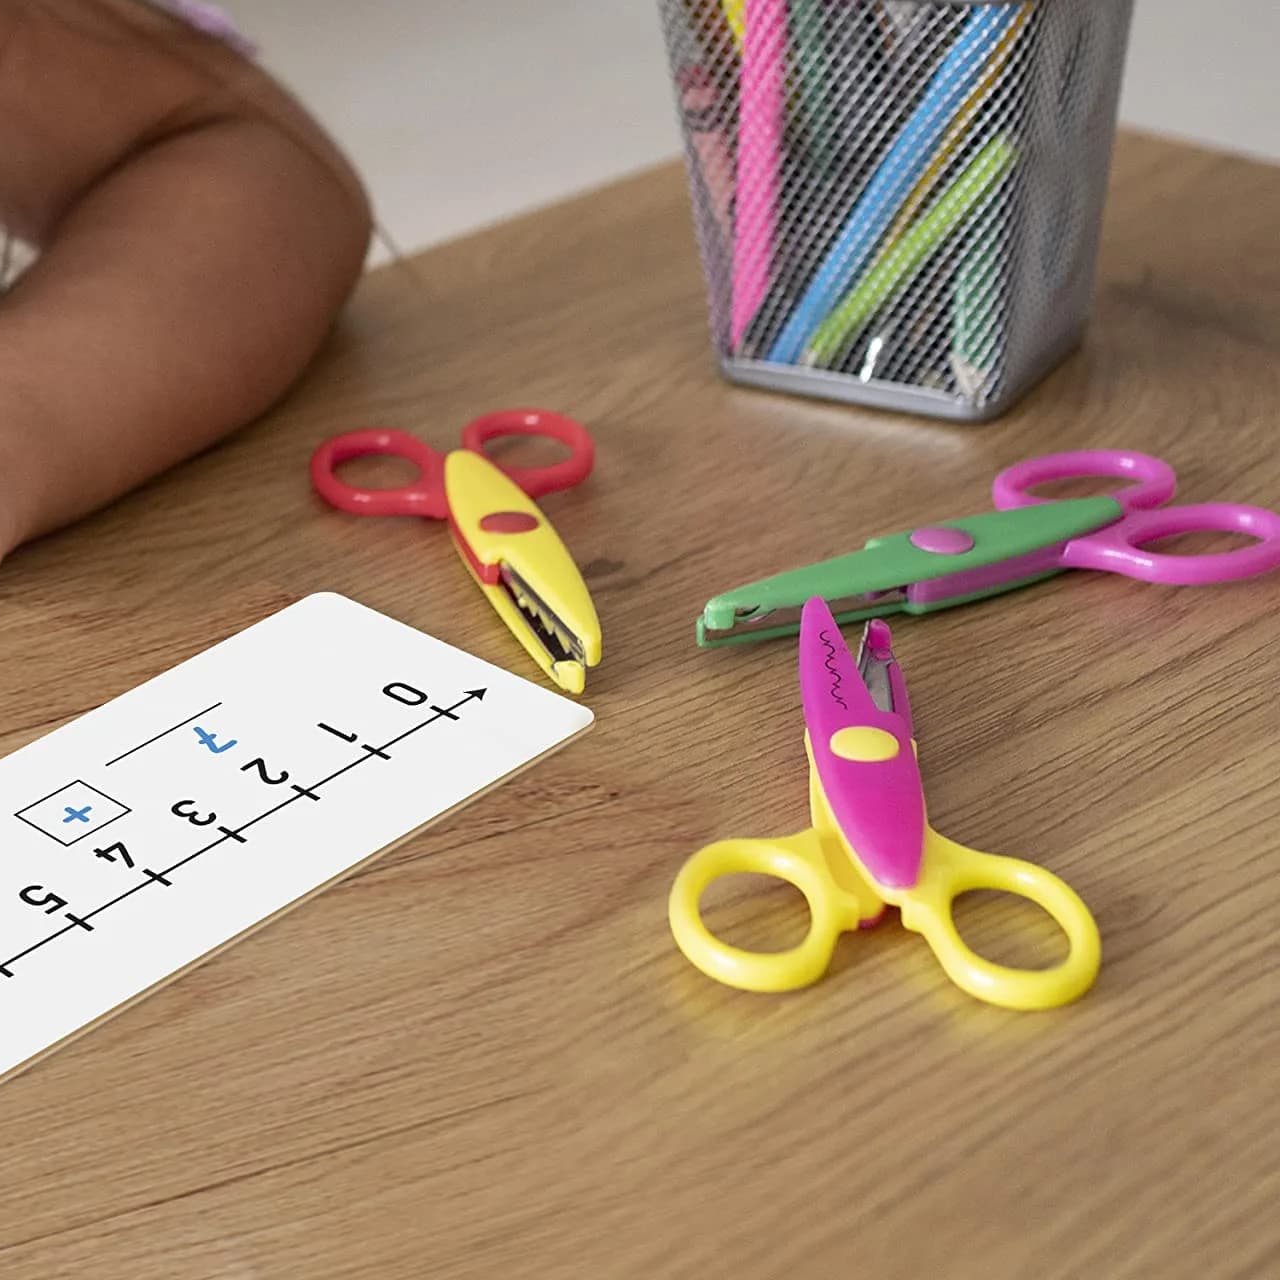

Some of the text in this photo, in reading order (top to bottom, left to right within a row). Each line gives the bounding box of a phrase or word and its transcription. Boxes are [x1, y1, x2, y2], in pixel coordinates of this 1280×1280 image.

[383, 683, 428, 706] 0
[193, 726, 238, 754] 7
[317, 723, 358, 743] 1
[240, 758, 289, 784] 2
[171, 800, 216, 826] 3
[93, 842, 134, 868] 4
[19, 885, 68, 914] 5
